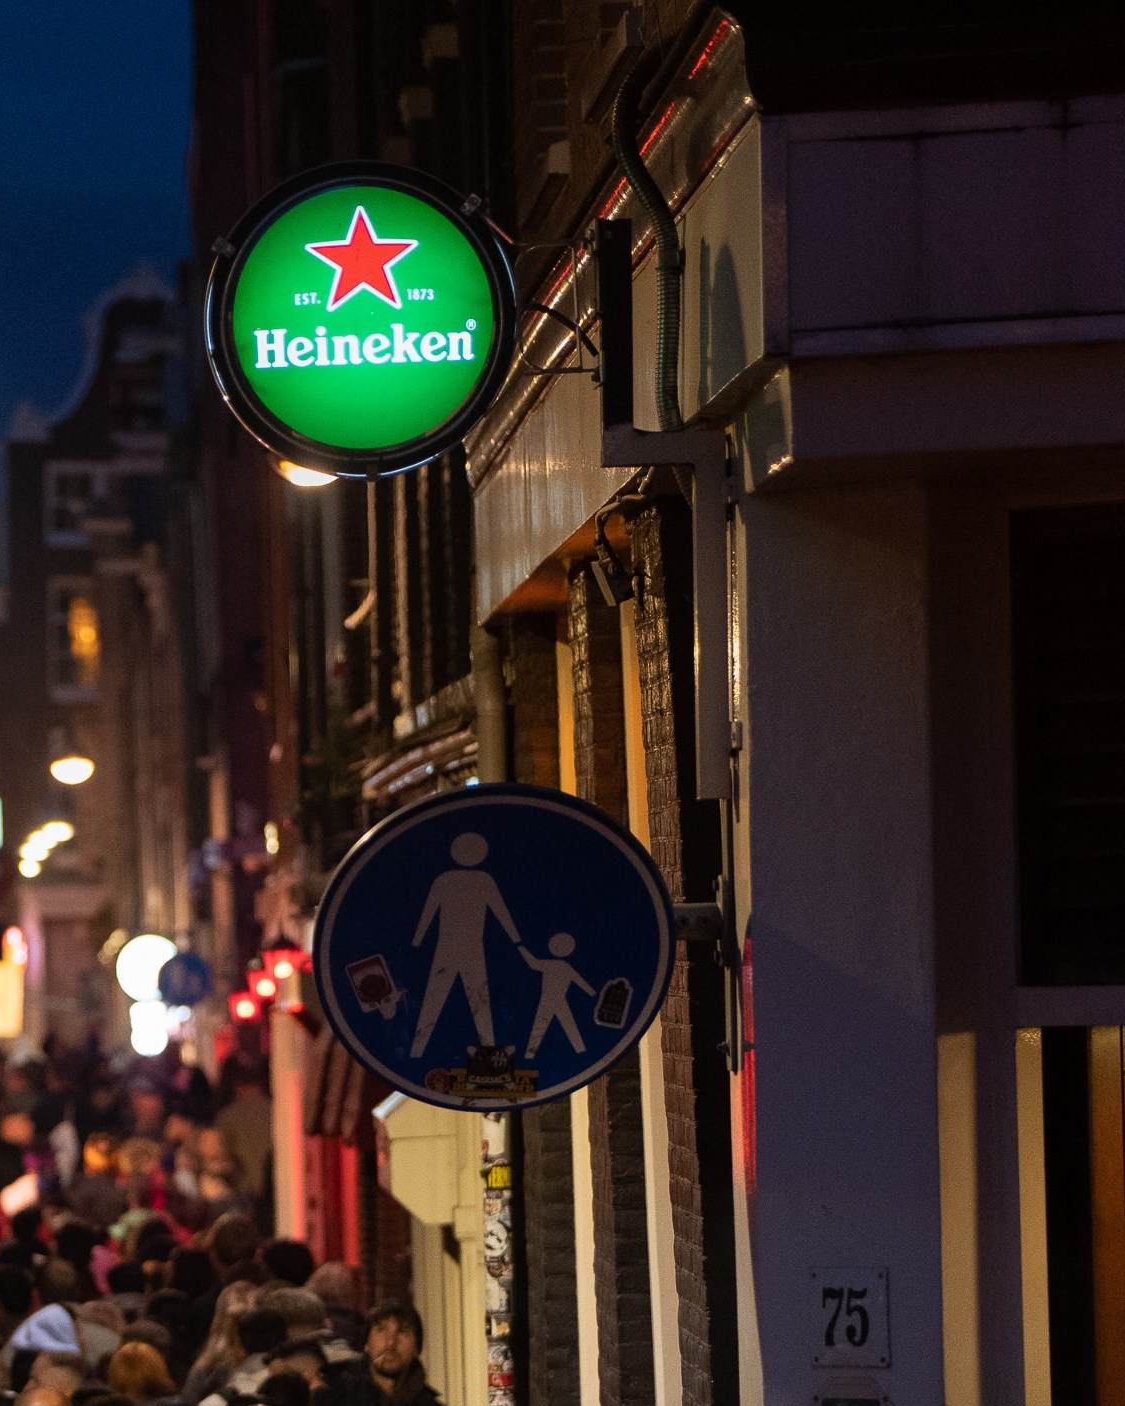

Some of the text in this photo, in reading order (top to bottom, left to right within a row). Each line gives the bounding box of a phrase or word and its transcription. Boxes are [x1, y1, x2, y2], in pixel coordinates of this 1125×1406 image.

[293, 288, 435, 306] EST. 1873
[821, 1286, 870, 1347] 75
